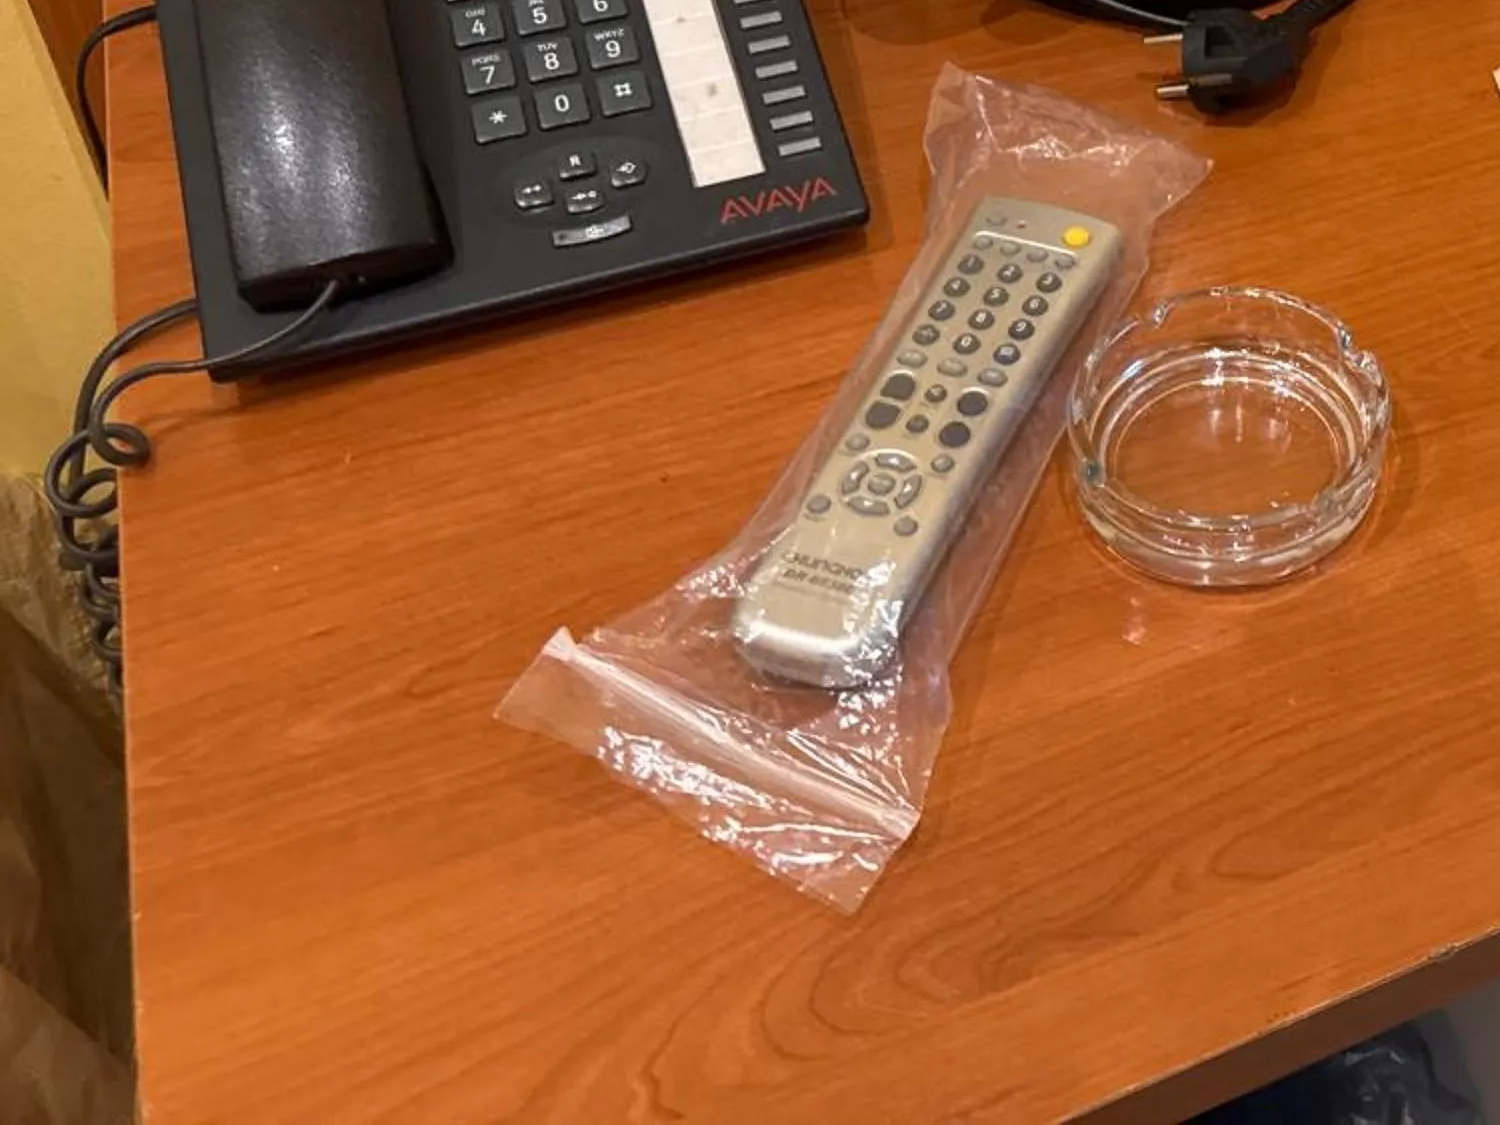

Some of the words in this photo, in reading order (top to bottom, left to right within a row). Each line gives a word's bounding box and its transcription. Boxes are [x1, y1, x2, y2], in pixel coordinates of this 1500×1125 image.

[533, 7, 547, 24] 5
[471, 19, 486, 36] 4
[605, 40, 621, 58] 9
[543, 52, 560, 70] 8
[480, 65, 495, 83] 7
[554, 94, 570, 112] 0
[720, 177, 838, 224] AVAYA
